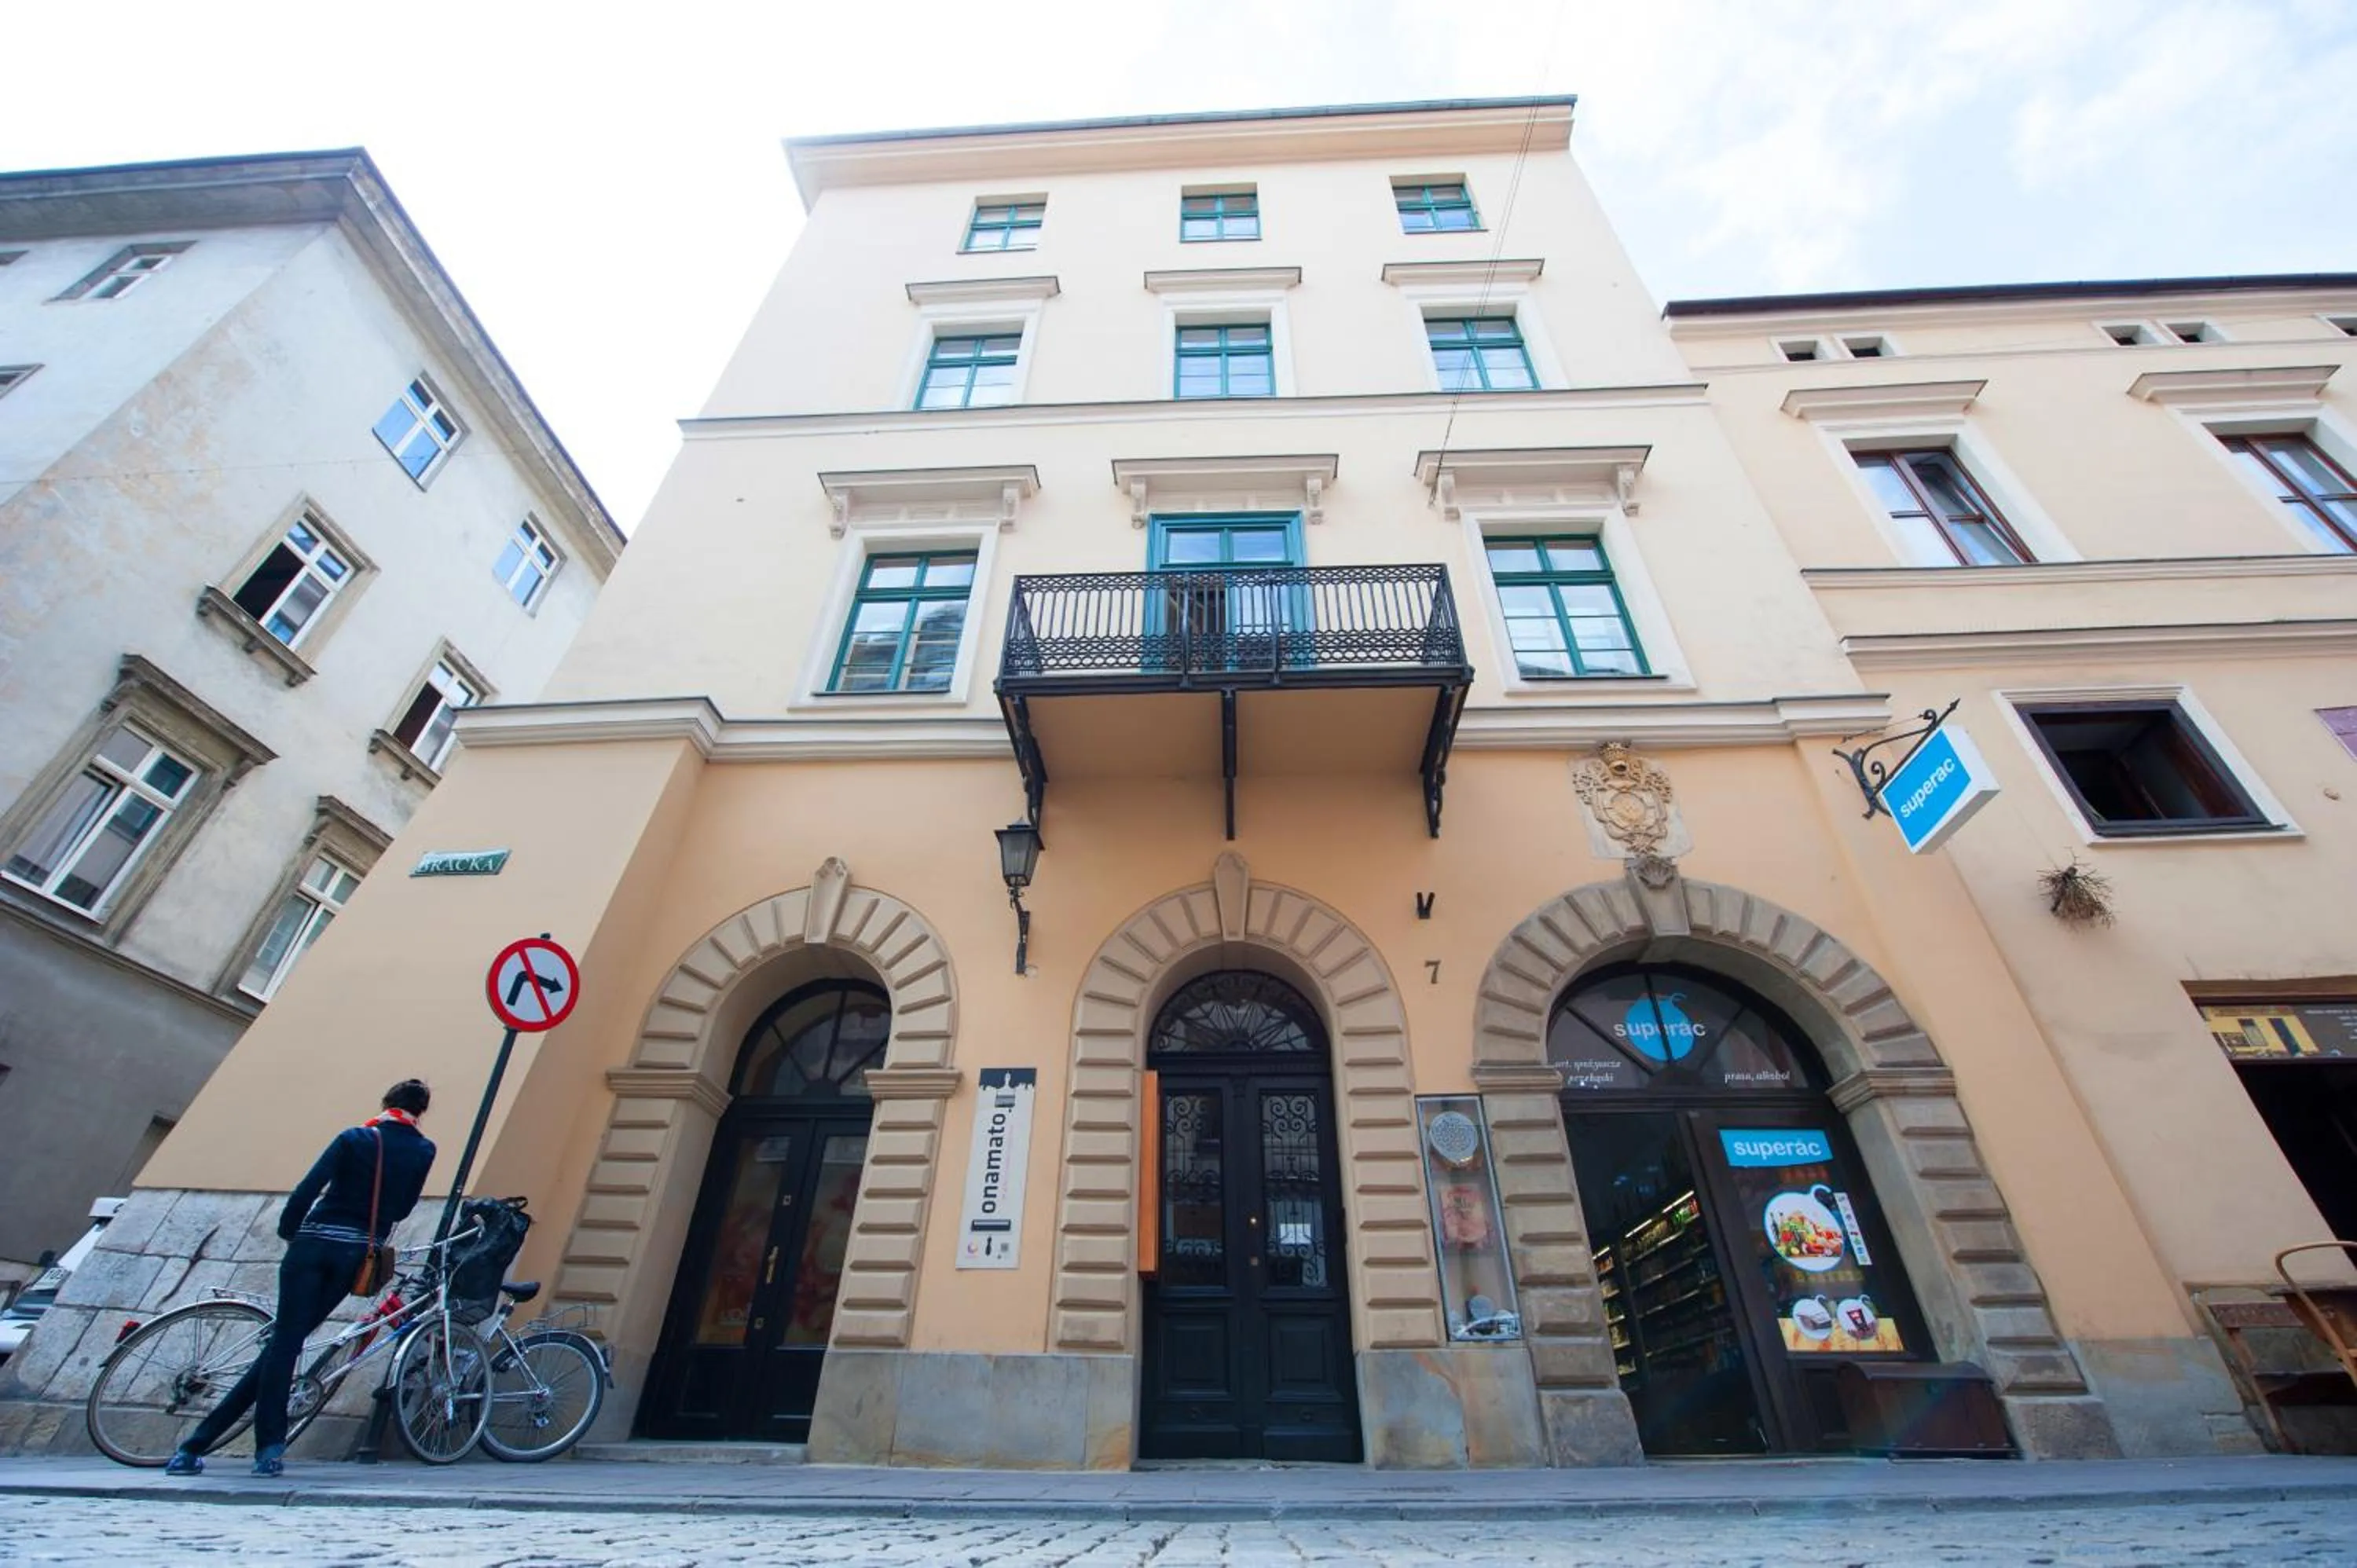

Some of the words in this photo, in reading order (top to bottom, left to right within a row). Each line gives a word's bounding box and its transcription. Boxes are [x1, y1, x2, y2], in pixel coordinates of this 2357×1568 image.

[1900, 757, 1956, 818] superac
[1424, 960, 1441, 984] 7
[981, 1113, 1006, 1213] onamato
